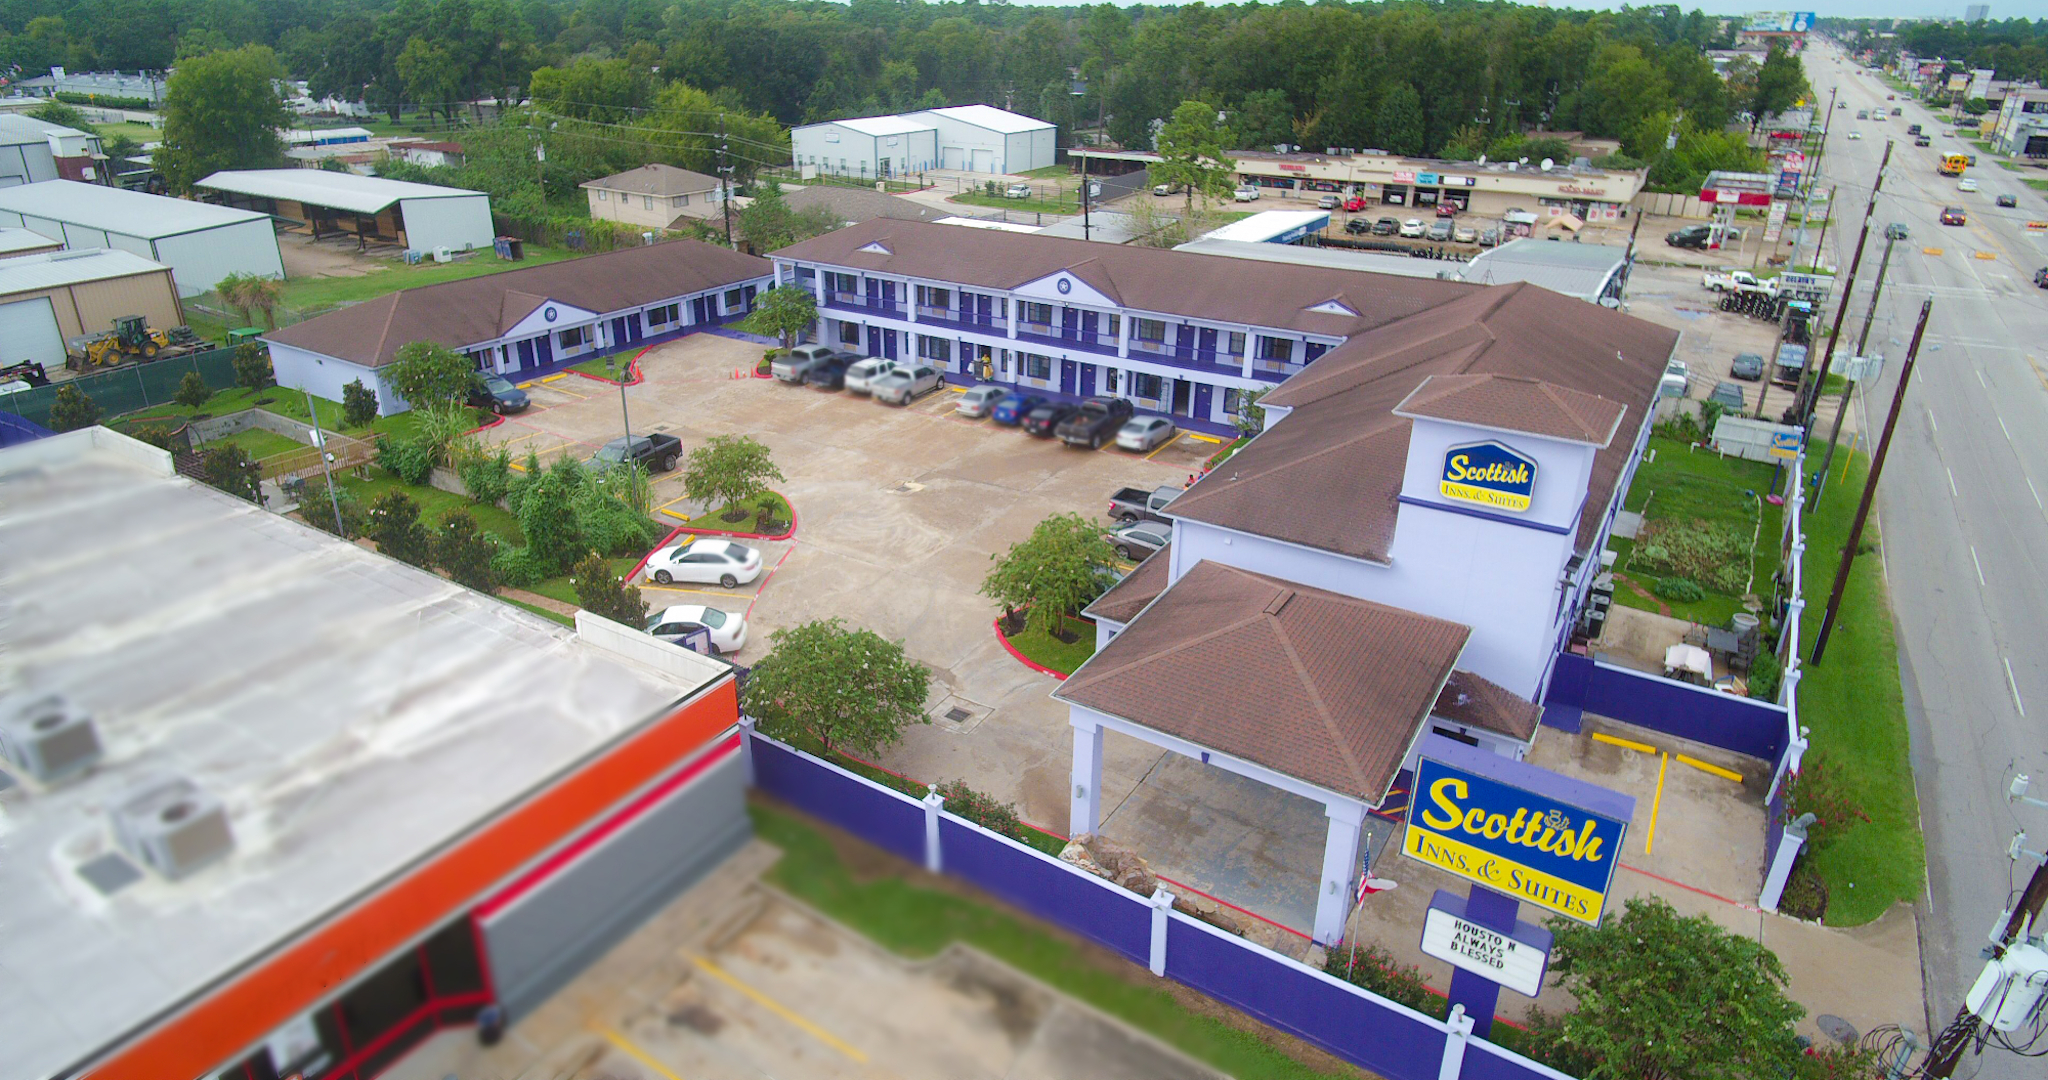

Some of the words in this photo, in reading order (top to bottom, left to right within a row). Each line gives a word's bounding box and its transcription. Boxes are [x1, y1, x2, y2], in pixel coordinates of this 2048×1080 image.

[1447, 454, 1529, 484] Scottish
[1473, 490, 1484, 500] &
[1487, 492, 1524, 509] SUITES
[1421, 777, 1603, 862] Scottish
[1477, 859, 1502, 882] &
[1508, 869, 1590, 916] SUITES
[1450, 941, 1504, 969] BLESSED
[1454, 932, 1504, 958] ALWAYS
